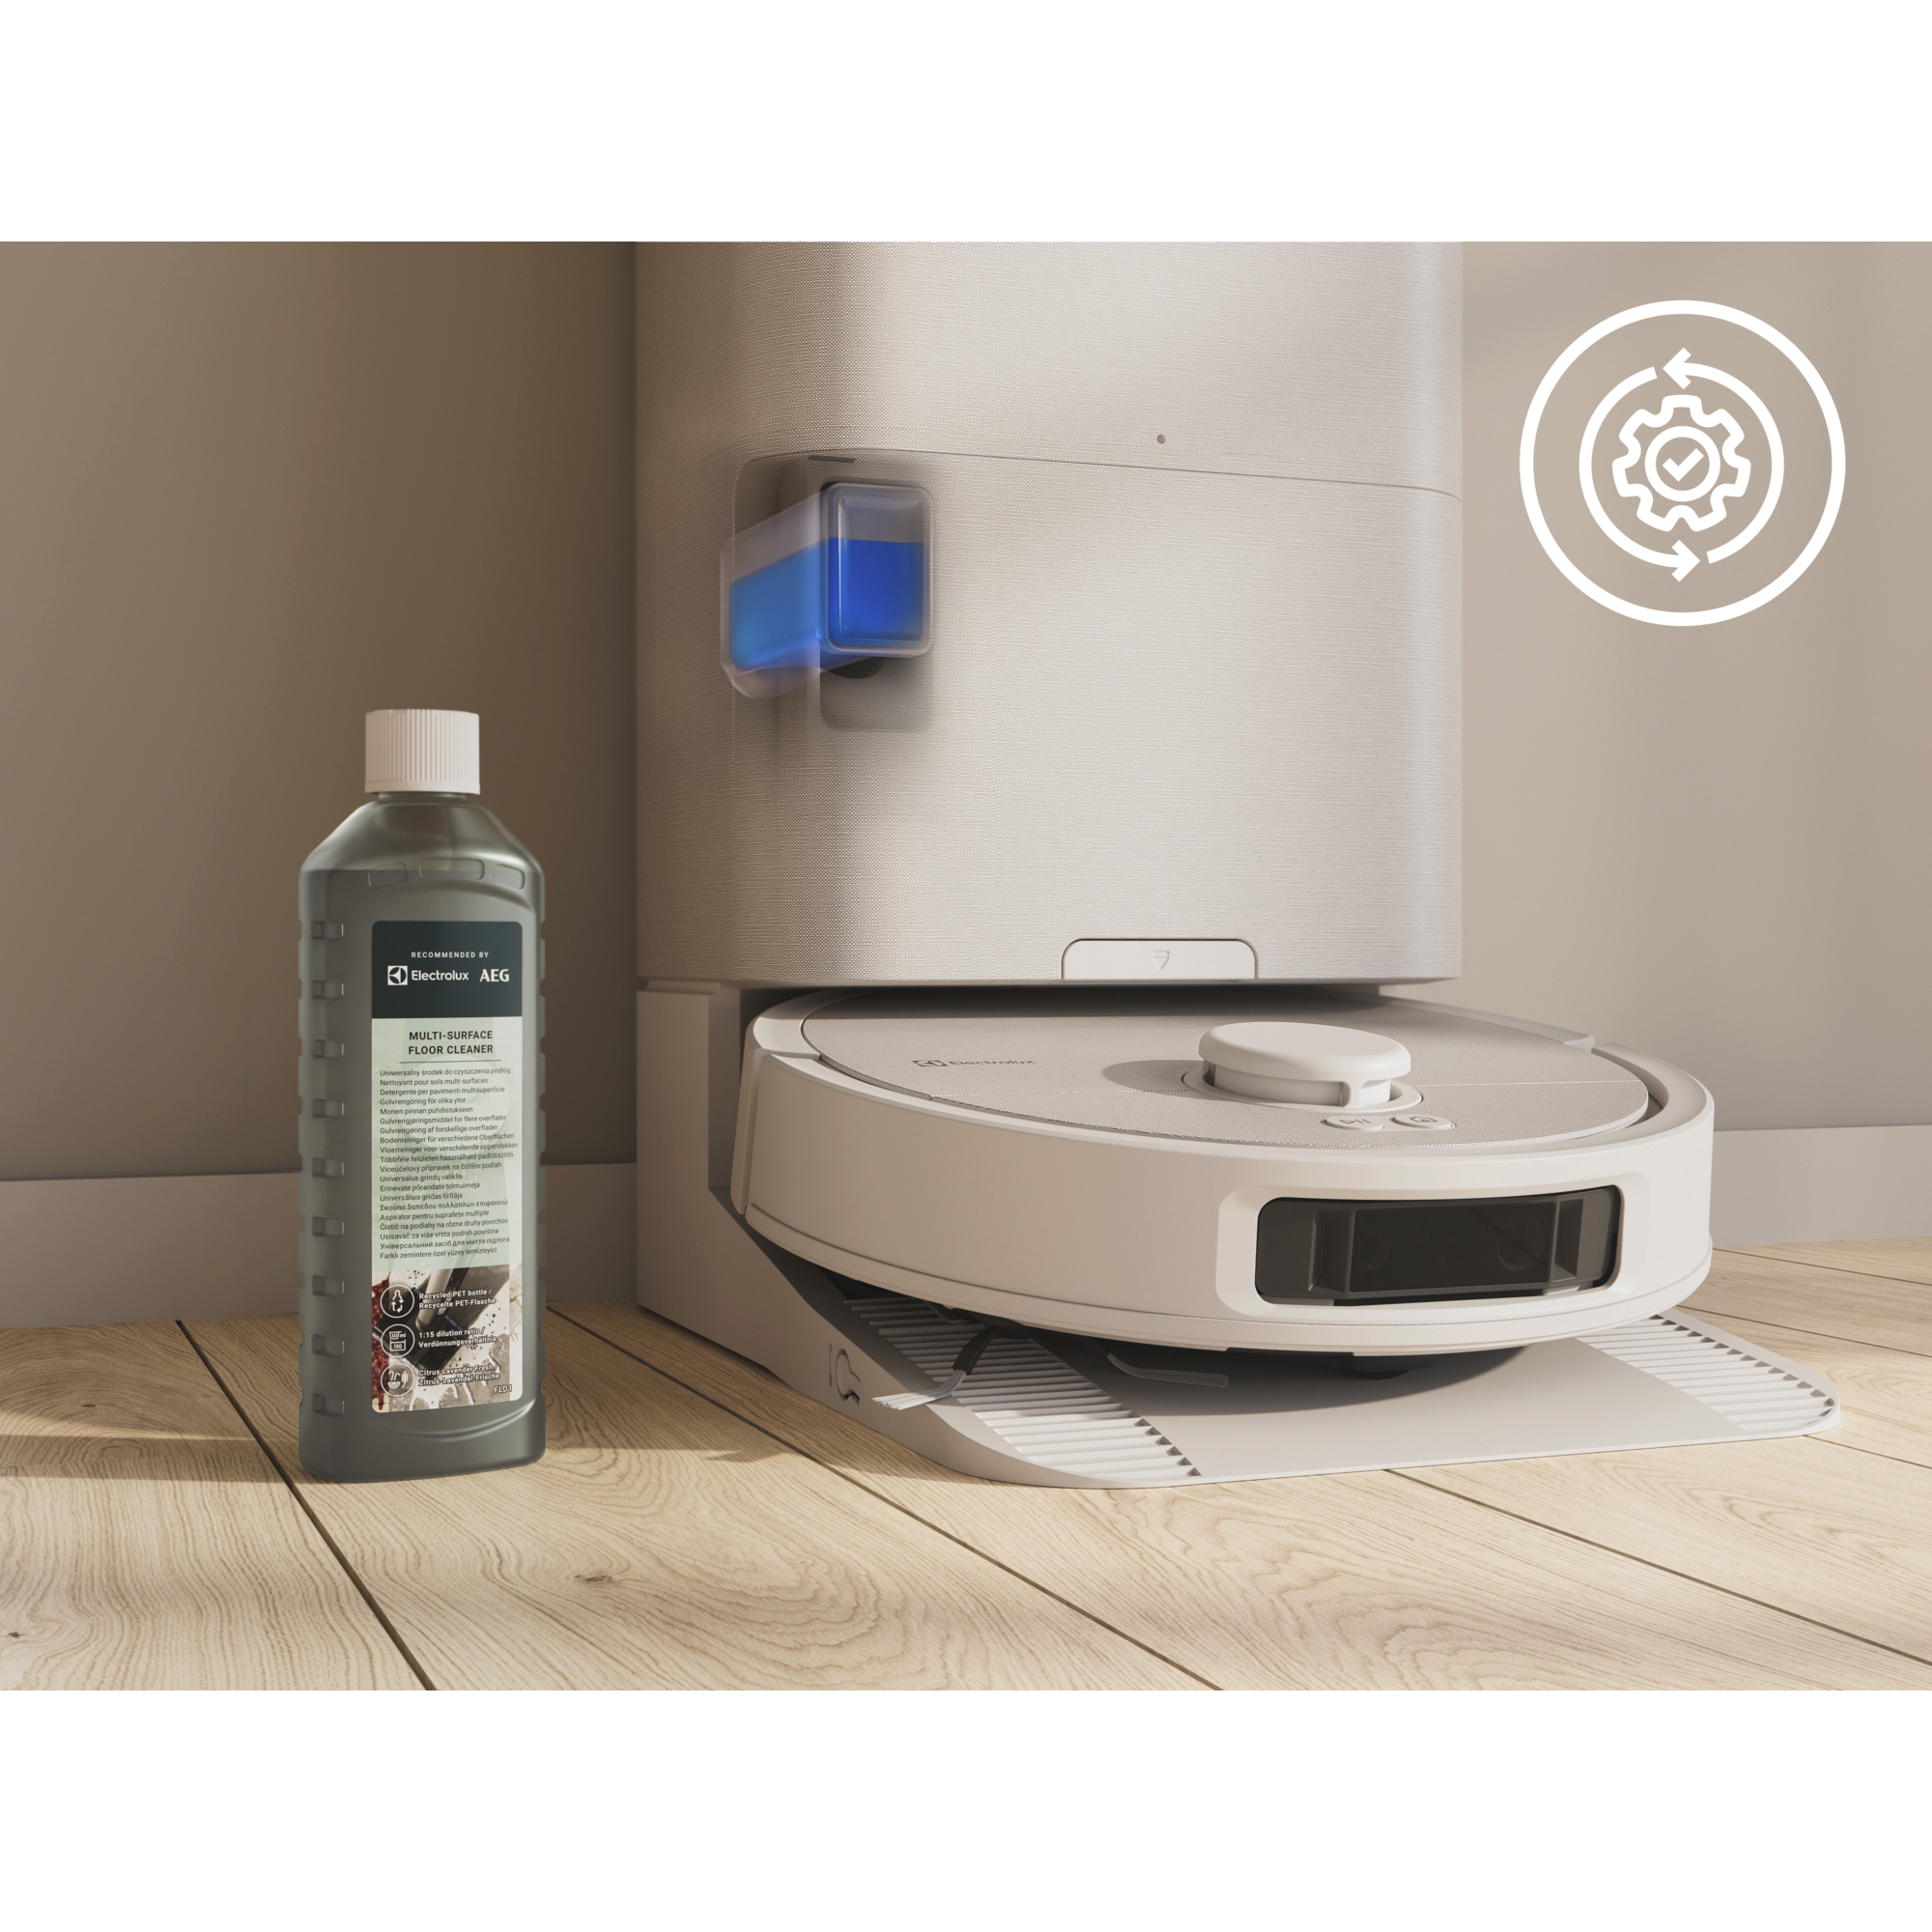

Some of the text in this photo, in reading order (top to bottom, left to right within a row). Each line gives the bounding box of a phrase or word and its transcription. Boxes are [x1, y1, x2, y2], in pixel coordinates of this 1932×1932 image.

[412, 969, 509, 981] Electrolux AEG
[409, 1031, 493, 1040] MULTI-SURFACE
[409, 1045, 493, 1055] FLOOR CLEANER
[454, 1067, 490, 1076] czyszczenia
[380, 1116, 453, 1124] Gulvrengjøringsmiddel
[480, 1142, 518, 1151] oppervlakken
[478, 1151, 513, 1160] padlótisztító
[421, 1164, 450, 1173] přípravek
[482, 1161, 501, 1170] podlah
[411, 1222, 436, 1231] podlahy
[380, 1241, 433, 1250] Універсальний
[418, 1292, 451, 1300] Recycled
[455, 1297, 497, 1306] PET-Flasche
[418, 1335, 497, 1348] Verdünnungsverhältnis
[441, 1366, 473, 1375] Lavender
[494, 1384, 512, 1394] FLD1
